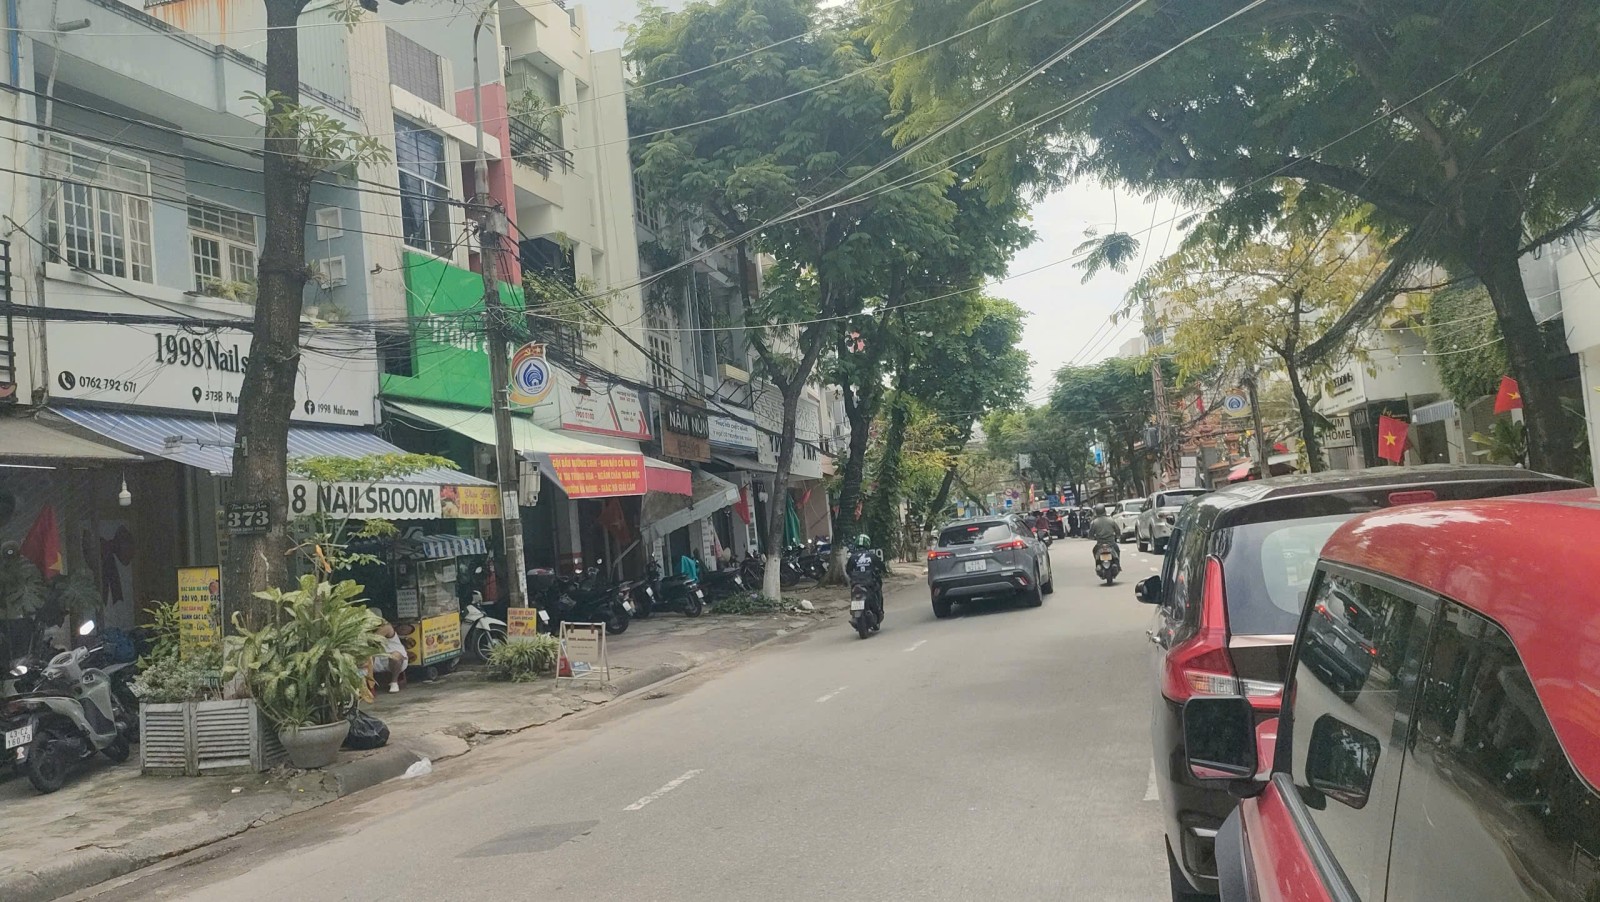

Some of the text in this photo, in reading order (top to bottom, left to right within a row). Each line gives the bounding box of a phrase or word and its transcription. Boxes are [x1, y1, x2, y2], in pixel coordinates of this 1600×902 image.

[155, 333, 249, 373] 1998 Nails
[79, 376, 137, 393] 0762 792 671
[205, 391, 239, 404] 373B Pha
[317, 404, 331, 414] 1998
[1325, 430, 1351, 441] HOME
[292, 484, 434, 514] 8 NAILSROOM
[228, 510, 269, 527] 373
